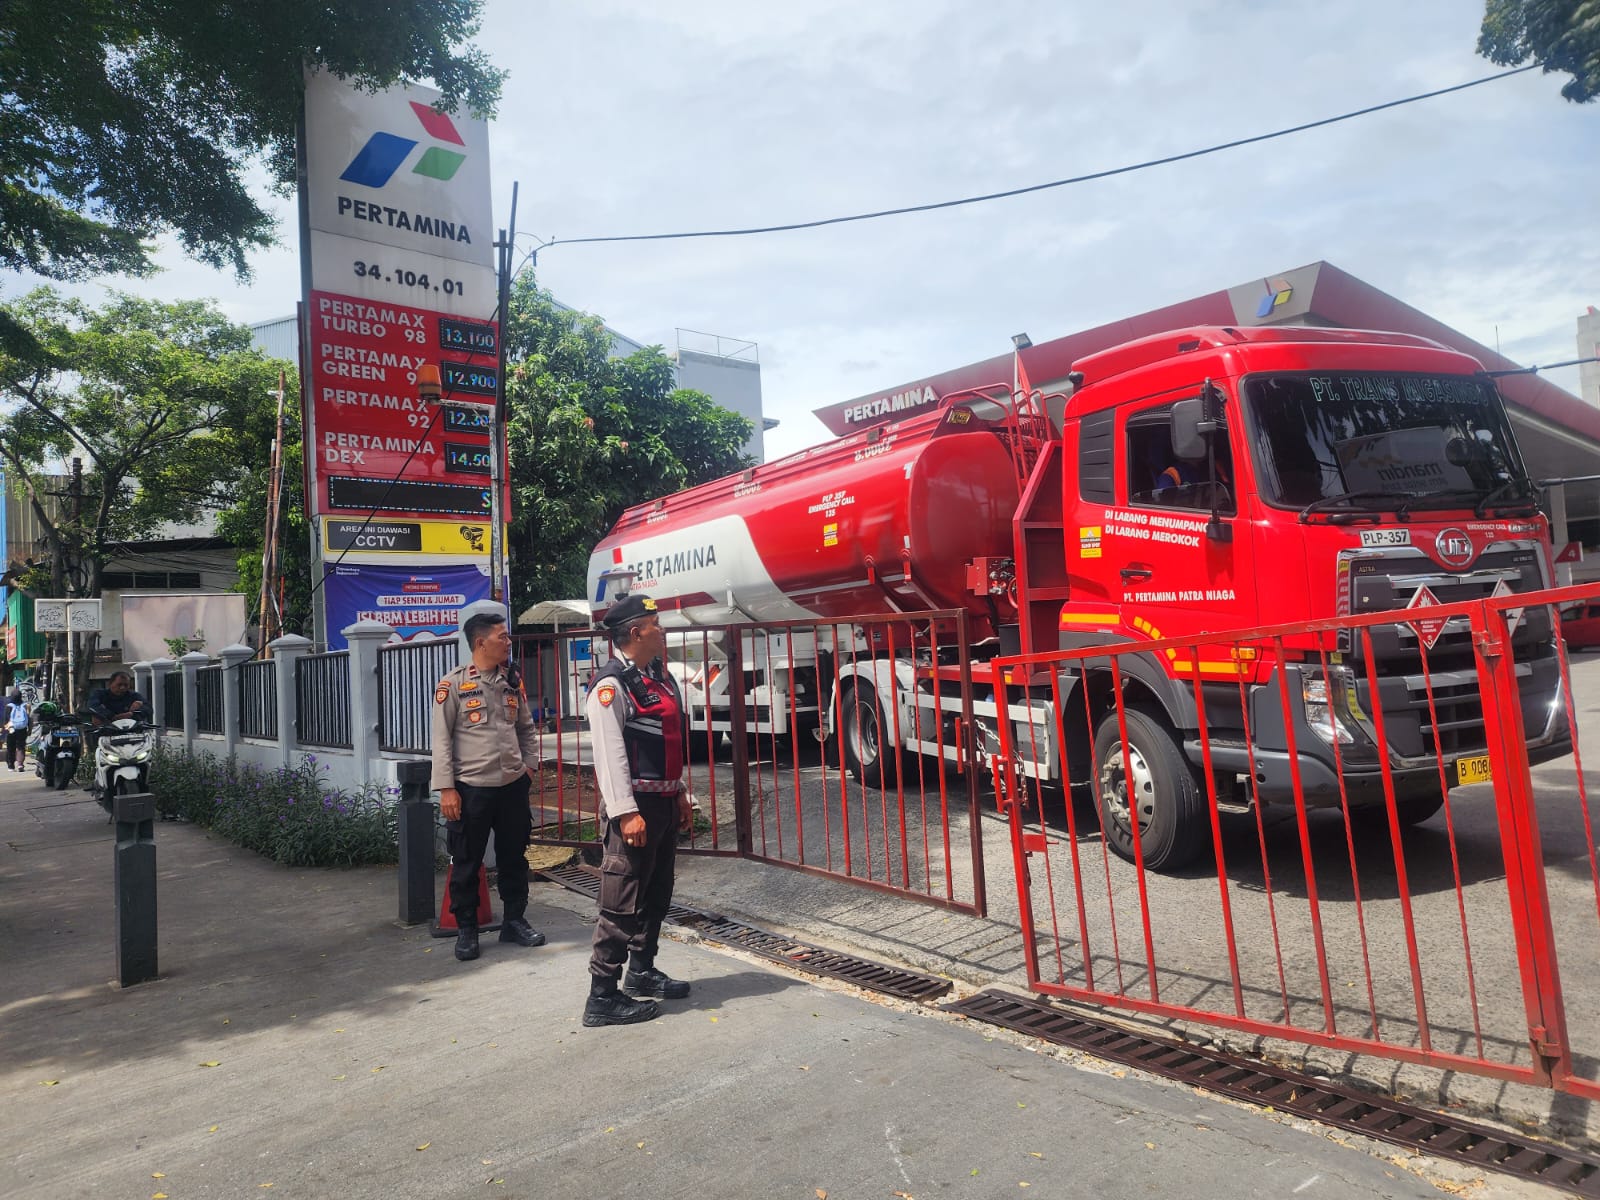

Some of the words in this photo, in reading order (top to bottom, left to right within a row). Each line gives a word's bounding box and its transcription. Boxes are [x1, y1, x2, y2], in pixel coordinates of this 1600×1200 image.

[338, 196, 472, 245] PERTAMINA
[353, 260, 464, 296] 34.104.01
[319, 298, 425, 329] PERTAMAX
[321, 315, 387, 338] TURBO
[404, 328, 426, 344] 98
[321, 343, 426, 370] PERTAMAX
[322, 360, 386, 382] GREEN
[406, 371, 418, 385] 9
[448, 370, 496, 389] 12.900
[1309, 377, 1340, 402] PT.
[323, 387, 428, 414] PERTAMAX
[844, 385, 936, 424] PERTAMINA
[407, 414, 430, 429] 92
[449, 410, 489, 428] 12.30
[325, 431, 435, 455] PERTAMINA
[325, 448, 366, 465] DEX
[451, 451, 490, 467] 14.50
[841, 495, 855, 505] CALL
[1105, 510, 1113, 519] DI
[1114, 511, 1147, 525] LARANG
[377, 526, 410, 534] DIAWASI
[1105, 525, 1114, 535] DI
[1115, 527, 1150, 540] LARANG
[1152, 532, 1199, 548] MEROKOK
[1363, 530, 1407, 544] PLP-357
[355, 535, 396, 547] CCTV
[628, 544, 716, 581] PERTAMINA
[383, 596, 401, 605] TIAP
[402, 596, 427, 605] SENIN
[433, 595, 459, 604] JUMAT
[1123, 592, 1134, 602] PT.
[1135, 591, 1177, 602] PERTAMINA
[1178, 590, 1204, 601] PATRA
[1205, 589, 1235, 601] NIAGA
[375, 611, 402, 624] BBM
[404, 609, 440, 624] LEBIH
[440, 609, 459, 624] HE
[1461, 763, 1467, 777] B
